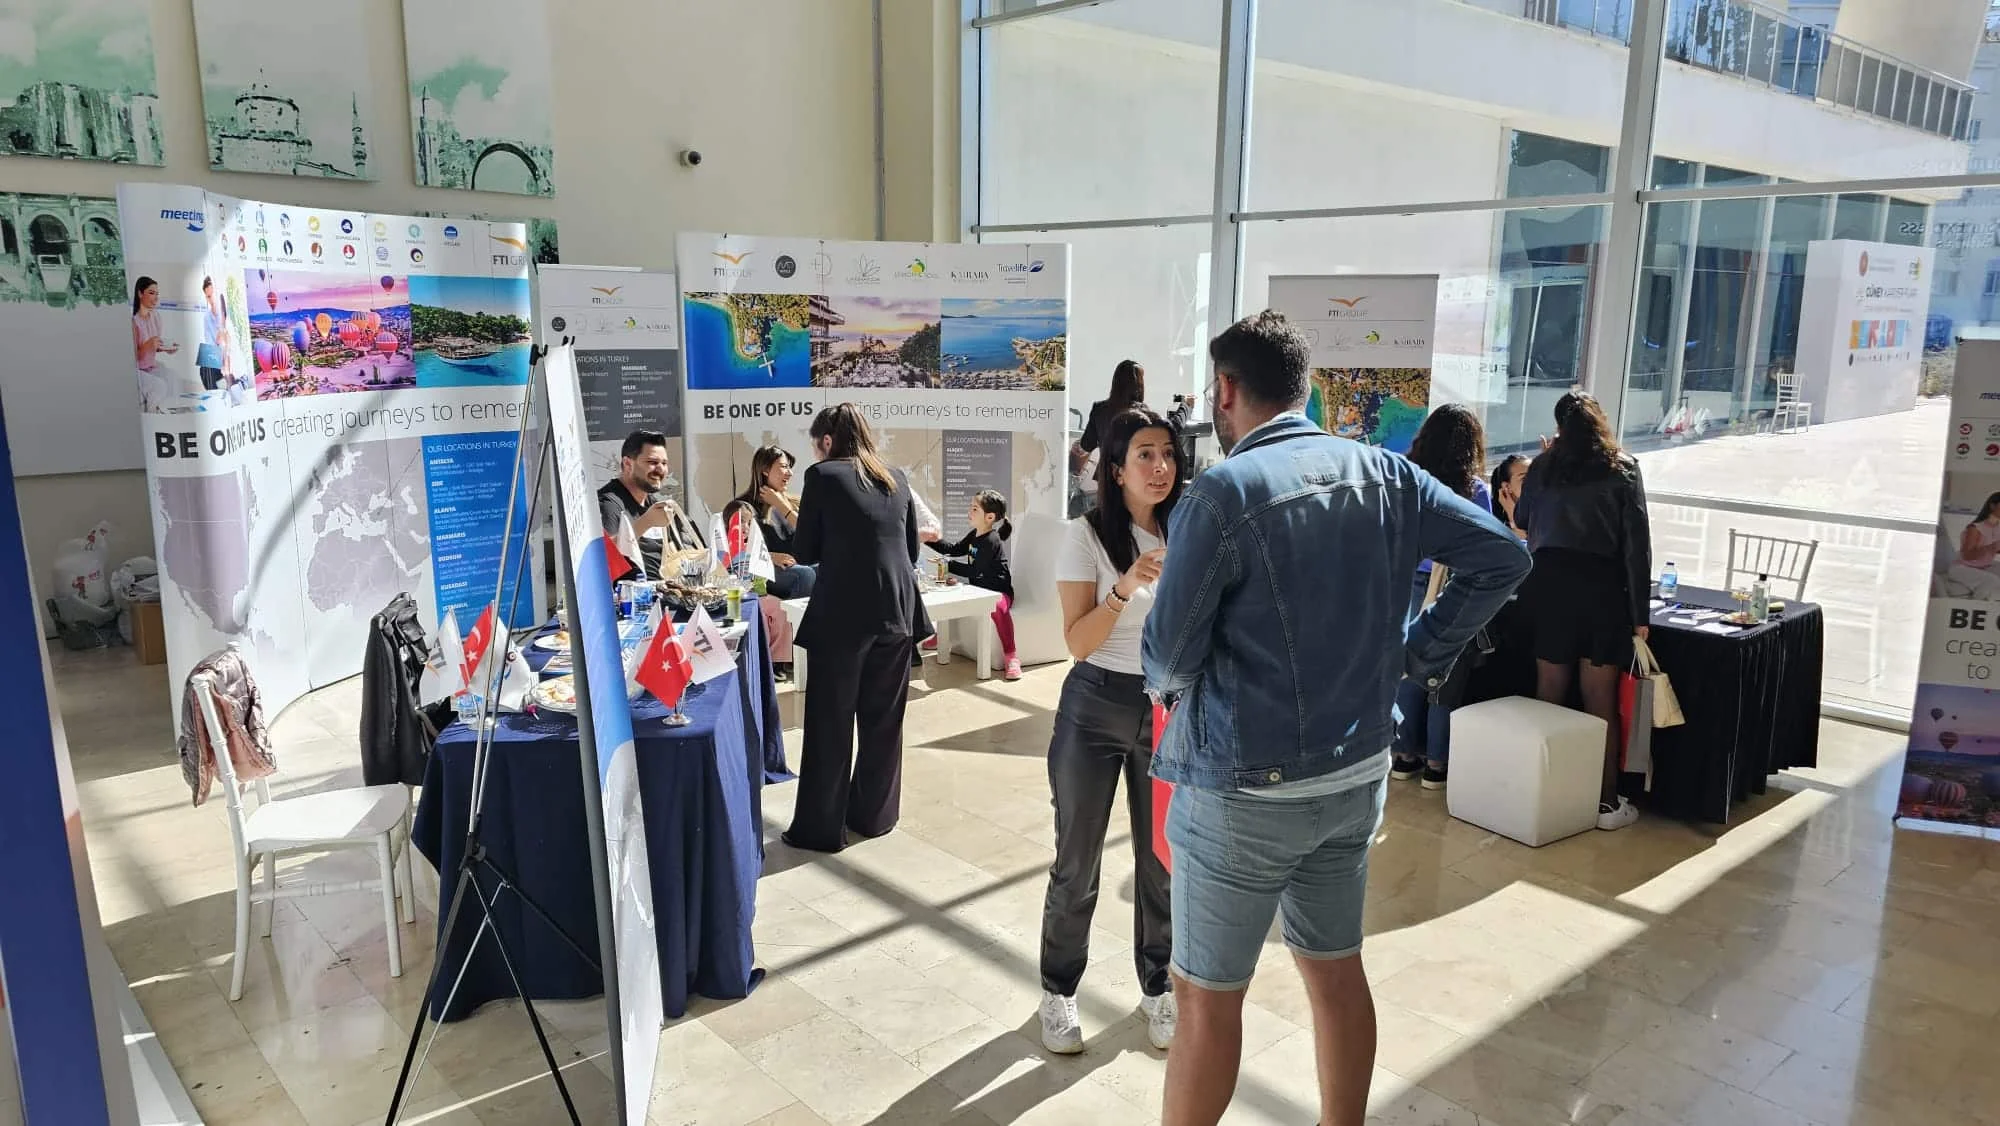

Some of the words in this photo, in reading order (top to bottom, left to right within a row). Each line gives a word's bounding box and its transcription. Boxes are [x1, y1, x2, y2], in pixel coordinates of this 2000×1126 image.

[703, 404, 725, 420] BE
[728, 403, 761, 419] ONE
[765, 402, 786, 417] OF
[791, 401, 813, 416] US
[885, 401, 951, 421] journeys
[956, 403, 970, 417] to
[975, 403, 1054, 420] remember
[155, 432, 199, 459] BE
[249, 417, 266, 443] US
[273, 410, 335, 438] creating
[339, 405, 425, 436] journeys
[432, 402, 453, 422] to
[461, 401, 537, 419] remem
[443, 442, 482, 452] LOCATIONS
[1949, 608, 1987, 631] BE
[1945, 640, 2000, 656] crea
[1967, 663, 1990, 680] to
